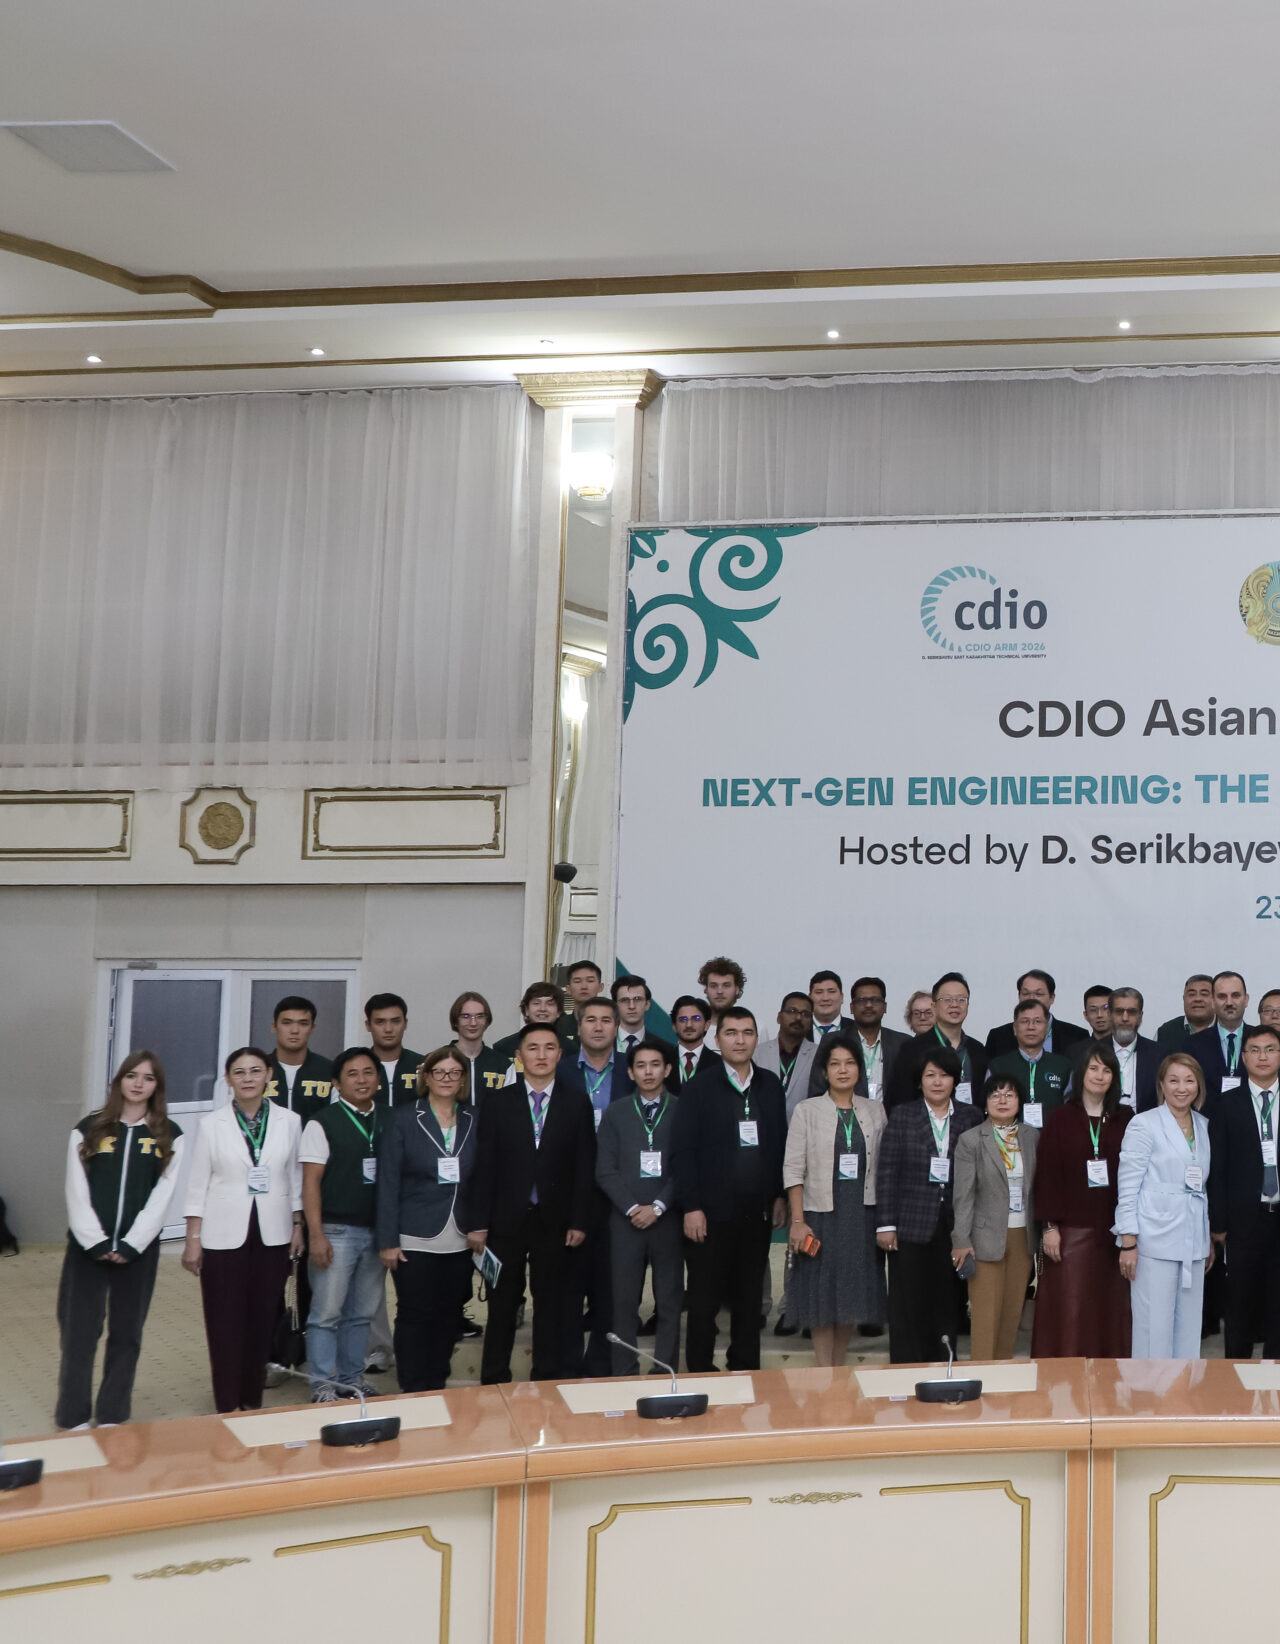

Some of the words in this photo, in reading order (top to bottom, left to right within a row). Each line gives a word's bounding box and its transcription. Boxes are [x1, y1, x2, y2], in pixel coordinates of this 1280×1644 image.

[954, 586, 1048, 631] cdio
[964, 642, 992, 652] CDIO
[993, 642, 1019, 652] ARM
[1020, 642, 1046, 652] 2026
[998, 699, 1126, 739] CDIO
[1142, 696, 1277, 737] Asian
[702, 776, 894, 808] NEXT-GEN
[907, 774, 1182, 806] ENGINEERING:
[1194, 773, 1270, 804] THE
[839, 833, 971, 866] Hosted
[985, 833, 1030, 873] by
[1041, 834, 1077, 865] D.
